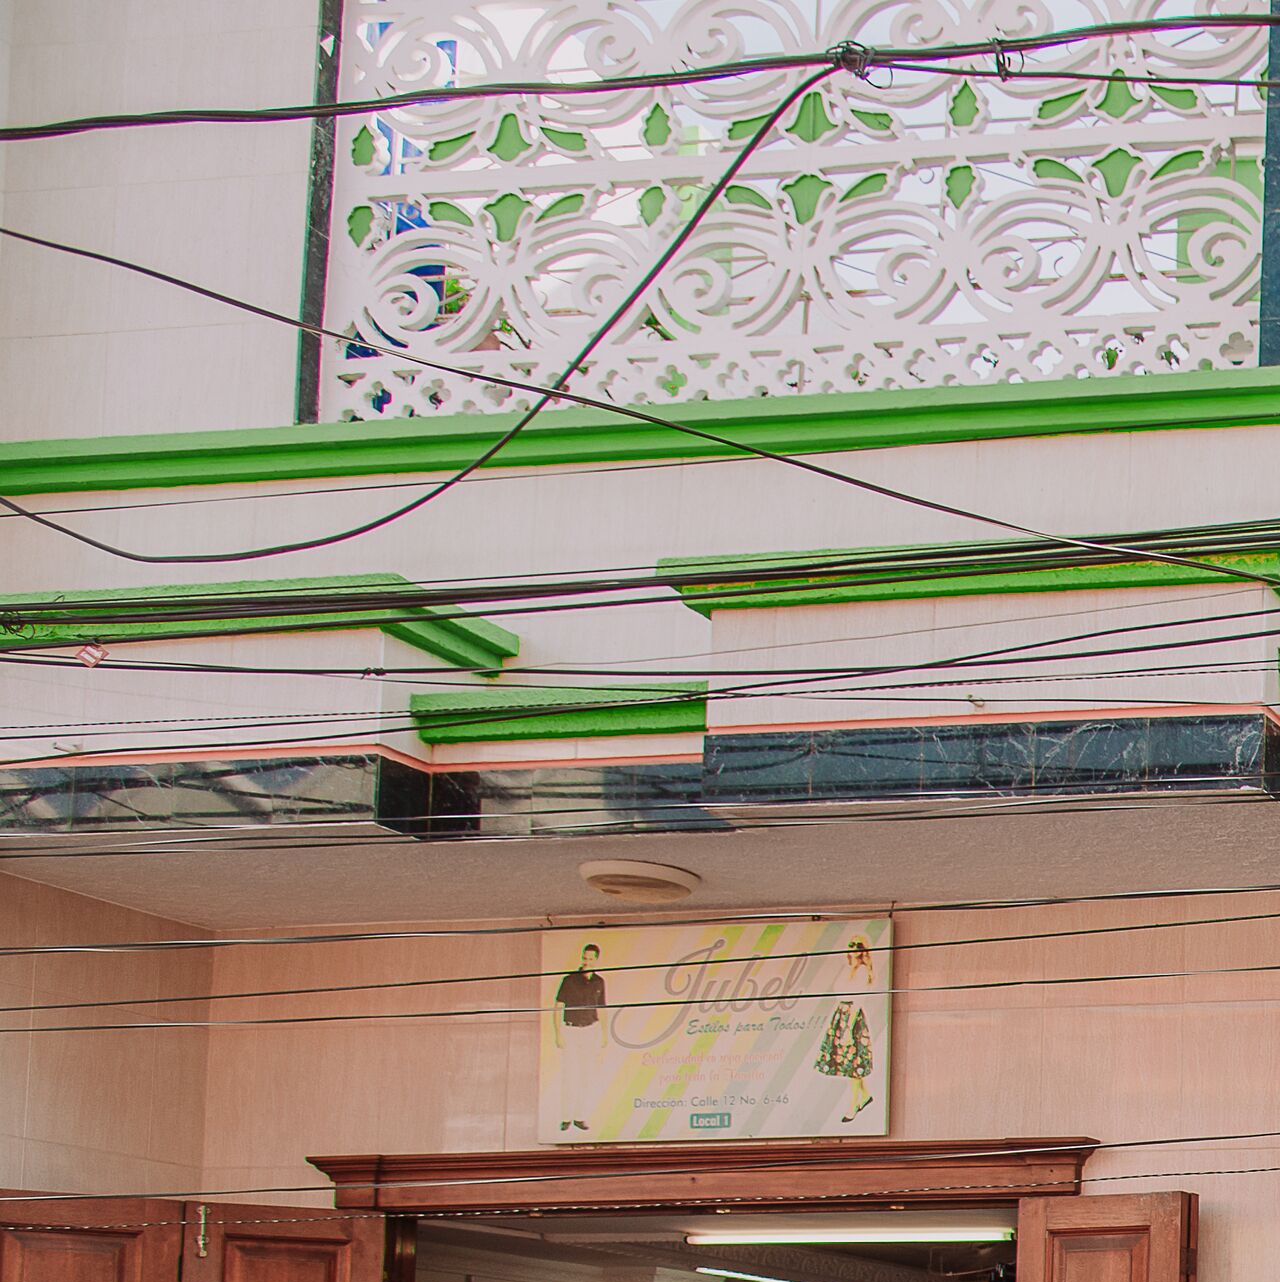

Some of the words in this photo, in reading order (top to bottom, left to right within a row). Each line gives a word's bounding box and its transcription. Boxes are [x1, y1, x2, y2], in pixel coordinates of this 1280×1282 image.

[686, 1018, 731, 1036] Estilos
[734, 1021, 766, 1036] para
[690, 1095, 719, 1108] Calle
[723, 1095, 736, 1107] 12
[763, 1093, 790, 1105] 6-46
[691, 1114, 721, 1128] Local
